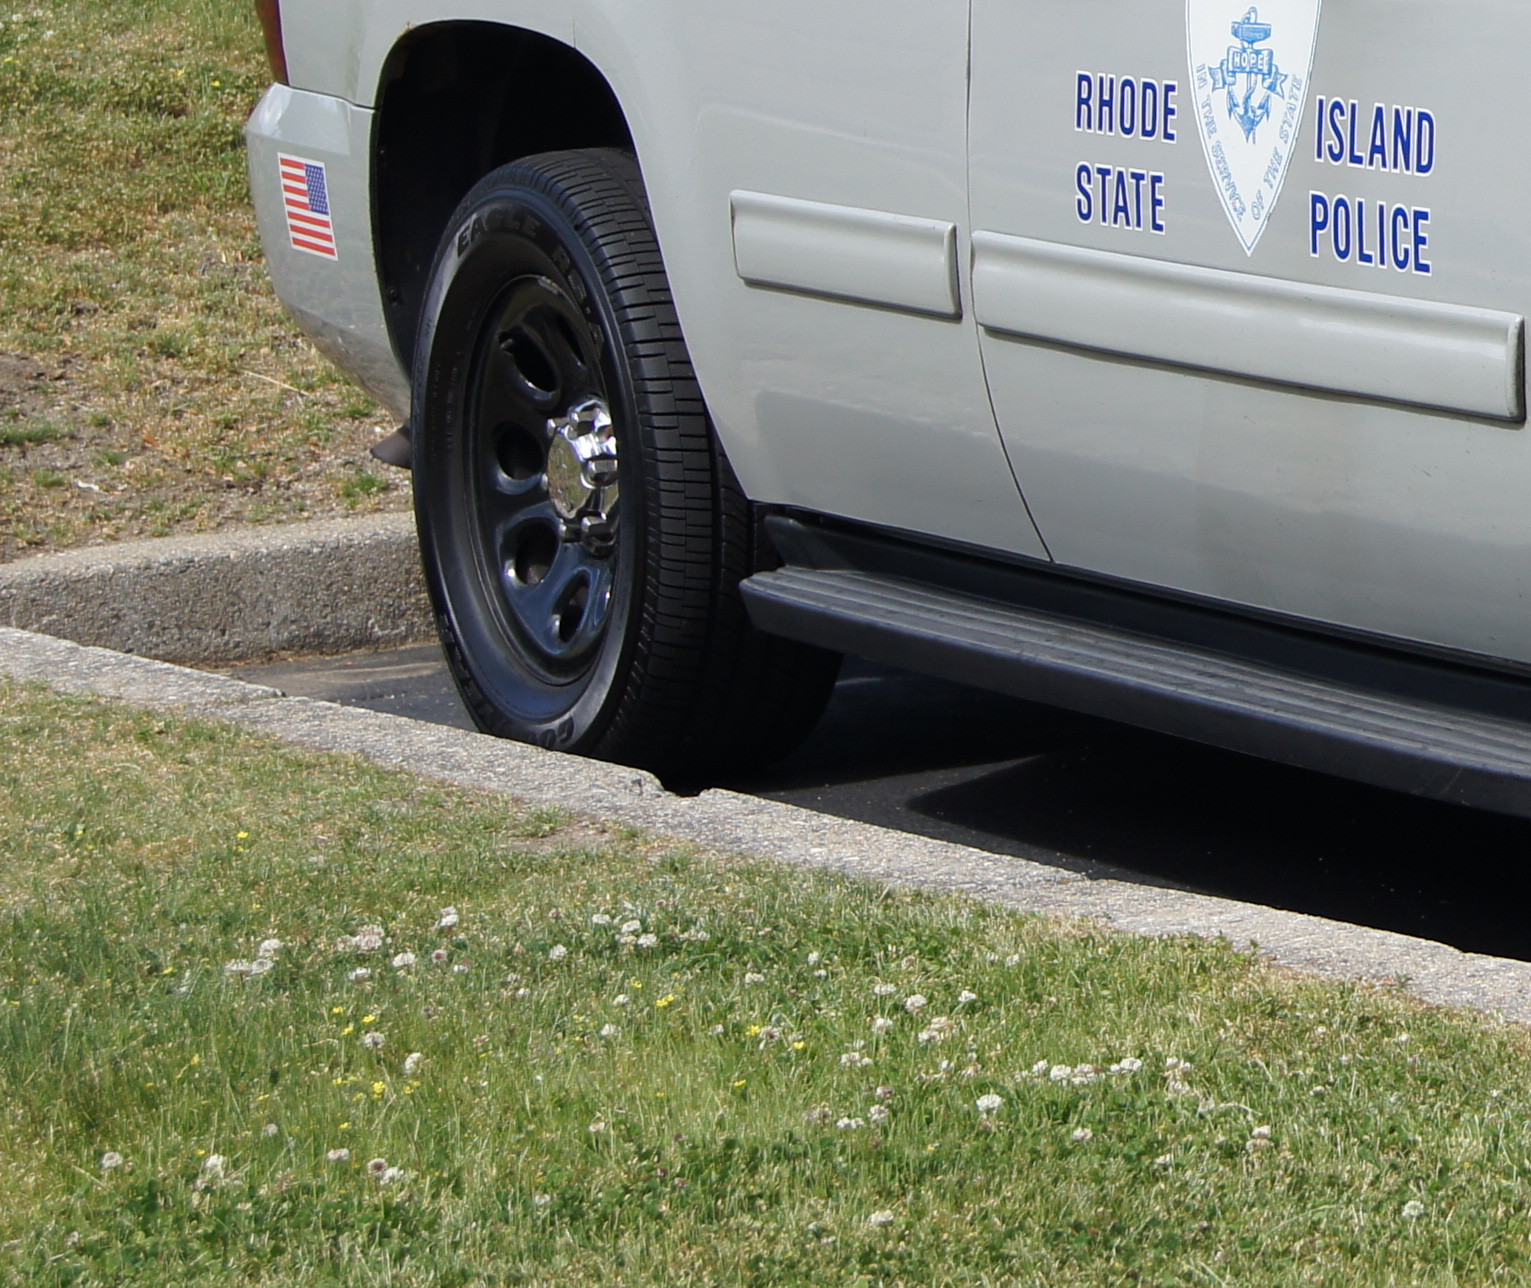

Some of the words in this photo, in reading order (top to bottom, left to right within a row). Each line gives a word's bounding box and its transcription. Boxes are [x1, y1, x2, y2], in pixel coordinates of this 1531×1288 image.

[1233, 51, 1265, 70] HOPE
[1074, 70, 1178, 144] RHODE
[1314, 95, 1437, 178] ISLAND
[1278, 73, 1303, 145] STATE
[457, 208, 541, 260] EAGLE
[1075, 161, 1166, 234] STATE
[1309, 190, 1432, 277] POLICE
